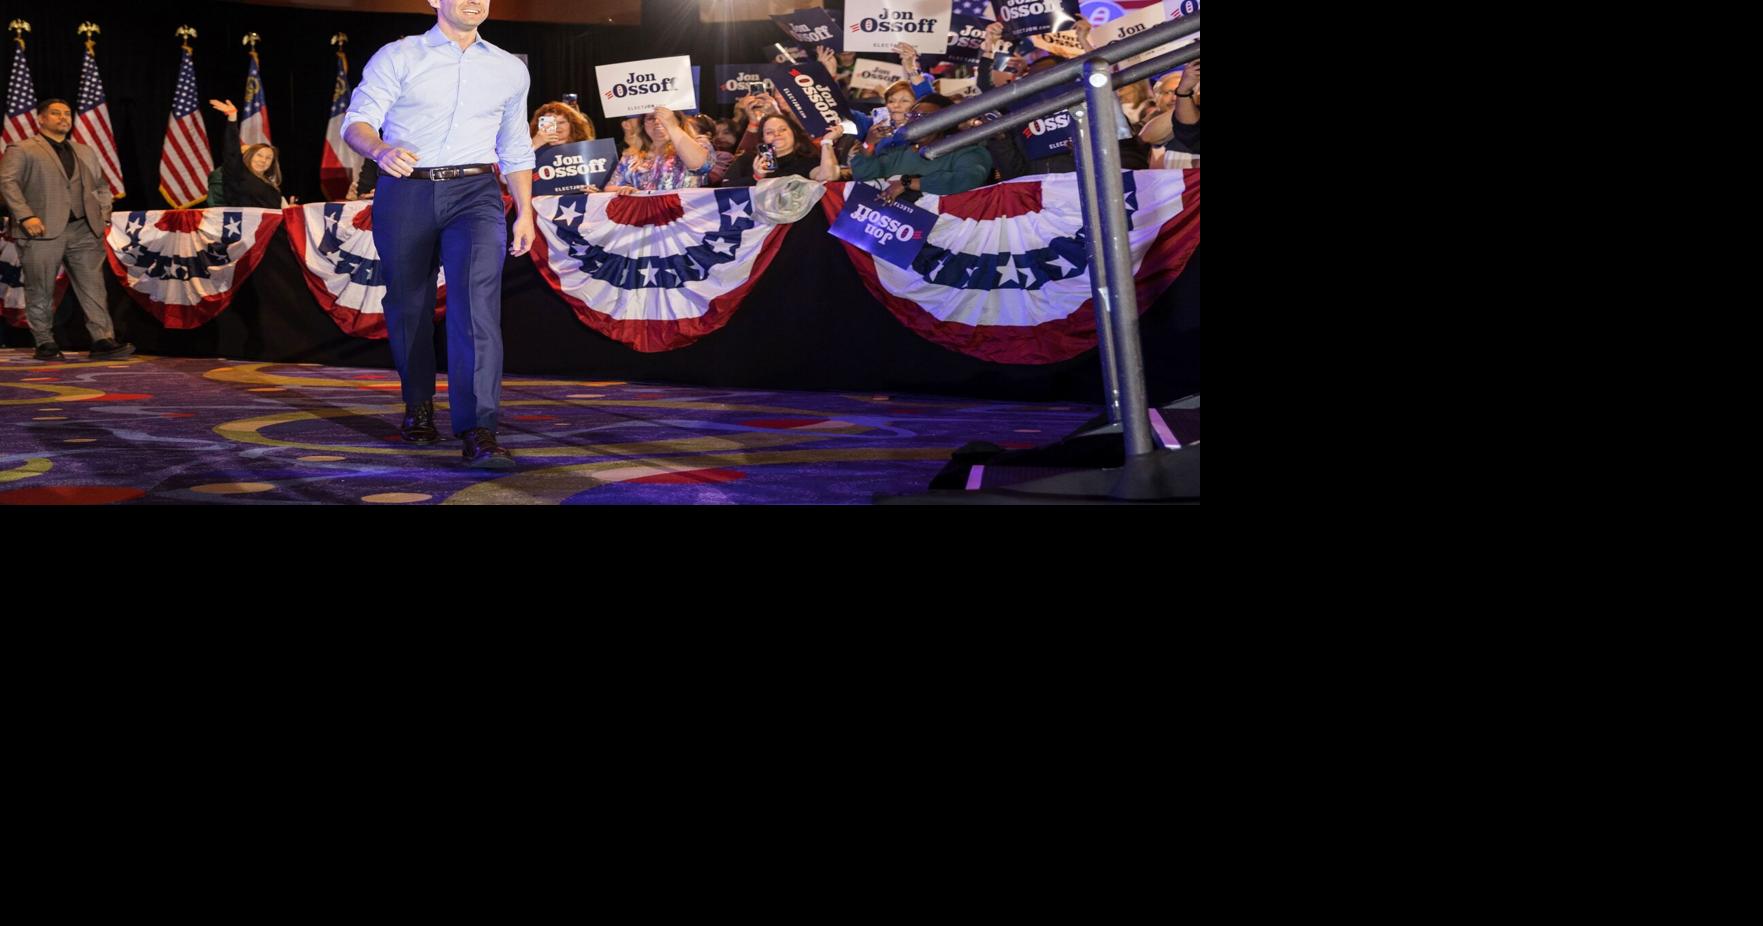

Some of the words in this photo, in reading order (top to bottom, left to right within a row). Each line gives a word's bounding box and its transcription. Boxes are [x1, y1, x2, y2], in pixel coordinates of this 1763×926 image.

[879, 8, 914, 20] Jon
[860, 17, 937, 33] Ossoff
[1118, 23, 1146, 38] Jon
[626, 72, 656, 85] Jon
[736, 72, 760, 82] Jon
[795, 74, 843, 126] Ossoff
[815, 84, 838, 108] Jon
[553, 154, 584, 167] Jon
[538, 158, 607, 180] Ossoff
[850, 204, 914, 242] Ossoff
[865, 223, 894, 245] Jon
